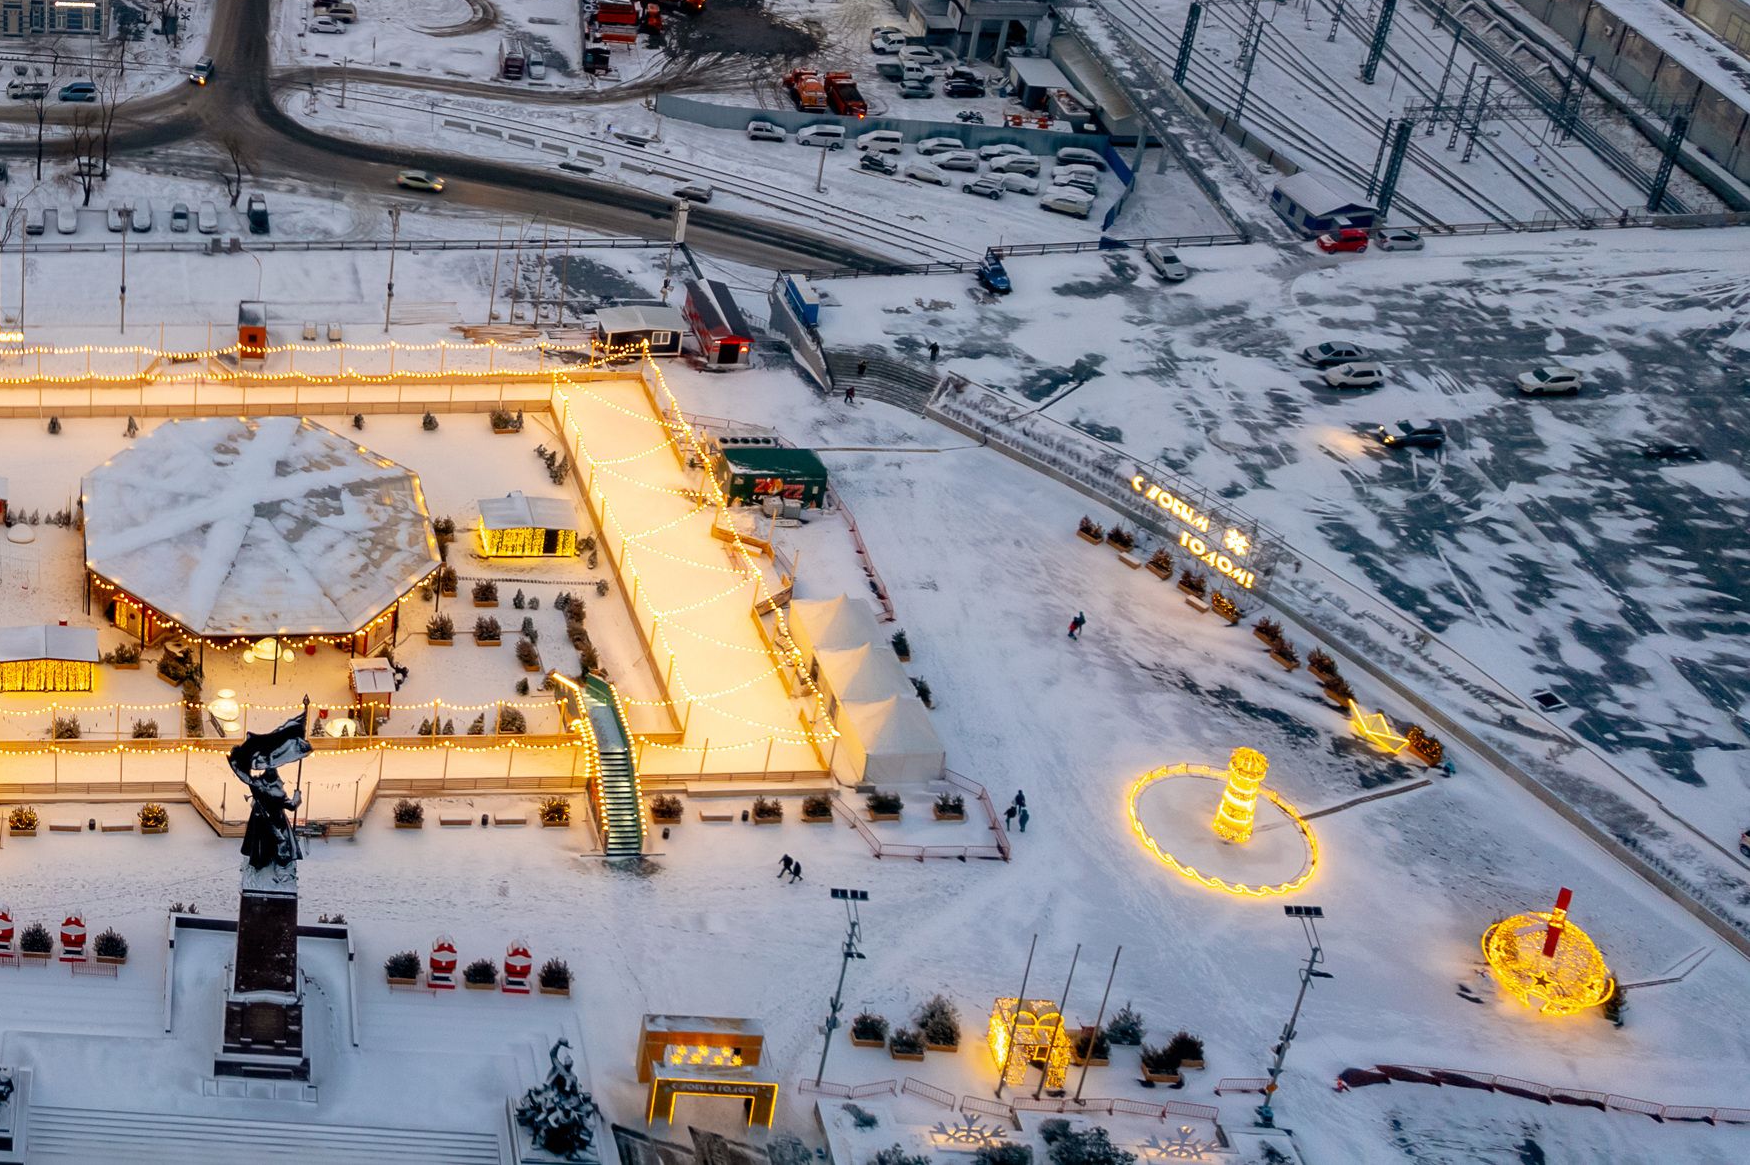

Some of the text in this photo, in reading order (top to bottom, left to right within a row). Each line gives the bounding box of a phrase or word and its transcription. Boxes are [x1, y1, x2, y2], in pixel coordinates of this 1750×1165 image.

[1131, 475, 1211, 533] С НОВЫМ
[1179, 530, 1256, 589] ГОДОМ!
